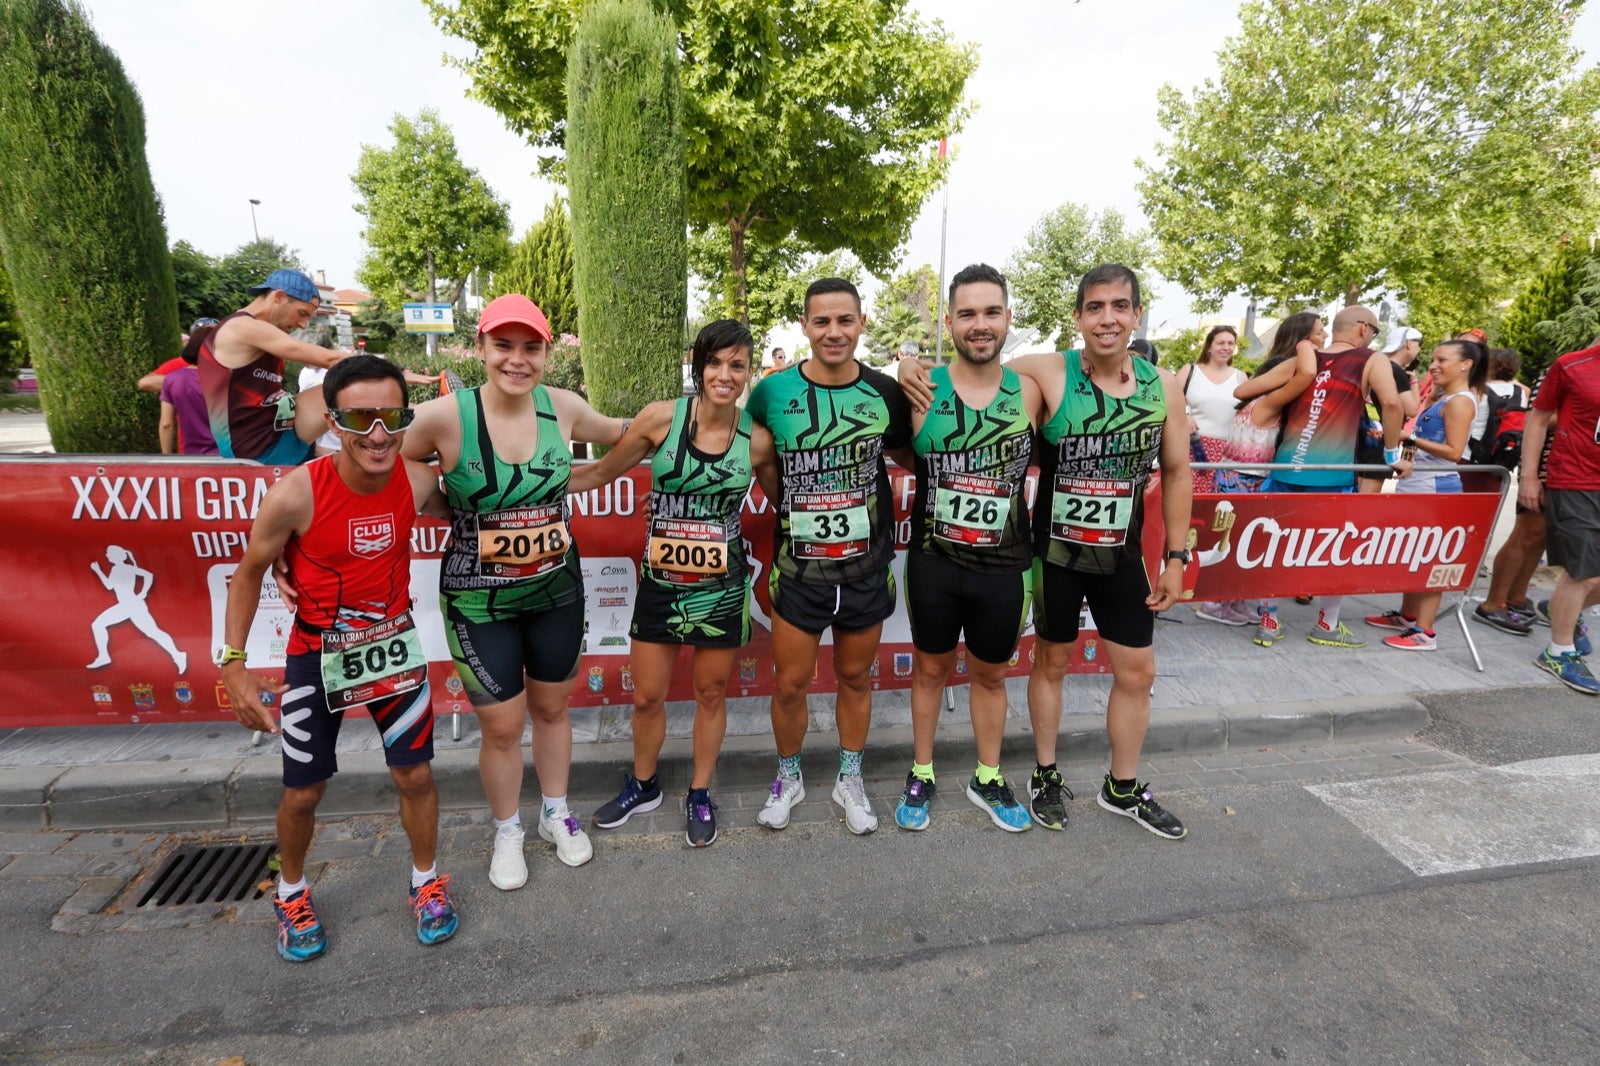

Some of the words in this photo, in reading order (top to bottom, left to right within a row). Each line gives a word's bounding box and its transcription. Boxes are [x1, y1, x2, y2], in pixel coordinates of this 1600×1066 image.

[1057, 436, 1103, 463] TEAM
[782, 451, 819, 476] TEAM
[923, 452, 965, 477] TEAM
[1080, 459, 1096, 470] DE
[801, 474, 815, 486] DE
[817, 466, 857, 483] MENTE
[955, 475, 968, 485] GRAN
[968, 477, 987, 487] PREMIO
[987, 479, 994, 488] DE
[1072, 480, 1085, 488] GRAN
[1086, 480, 1106, 489] PREMIO
[1106, 482, 1113, 490] DE
[1114, 482, 1130, 490] FONDO
[70, 476, 182, 520] XXXII
[195, 477, 276, 520] GRA
[568, 476, 634, 516] NDO
[807, 494, 821, 504] GRAN
[821, 493, 841, 503] PREMIO
[841, 493, 848, 501] DE
[847, 491, 863, 501] FONDO
[500, 511, 517, 521] GRAN
[517, 510, 539, 521] PREMIO
[539, 508, 546, 518] DE
[949, 495, 999, 525] 126
[1065, 497, 1117, 525] 221
[354, 523, 392, 538] CLUB
[667, 521, 680, 531] GRAN
[680, 523, 700, 533] PREMIO
[700, 524, 707, 533] DE
[707, 525, 723, 535] FONDO
[813, 513, 850, 539] 33
[493, 528, 565, 558] 2018
[1236, 515, 1467, 573] Cruzcampo
[445, 553, 475, 576] QUE
[660, 542, 722, 569] 2003
[1429, 569, 1460, 586] SIN
[345, 631, 365, 641] GRAN
[365, 622, 387, 638] PREMIO
[342, 638, 409, 680] 509
[461, 640, 476, 657] QUE
[468, 656, 482, 669] DE
